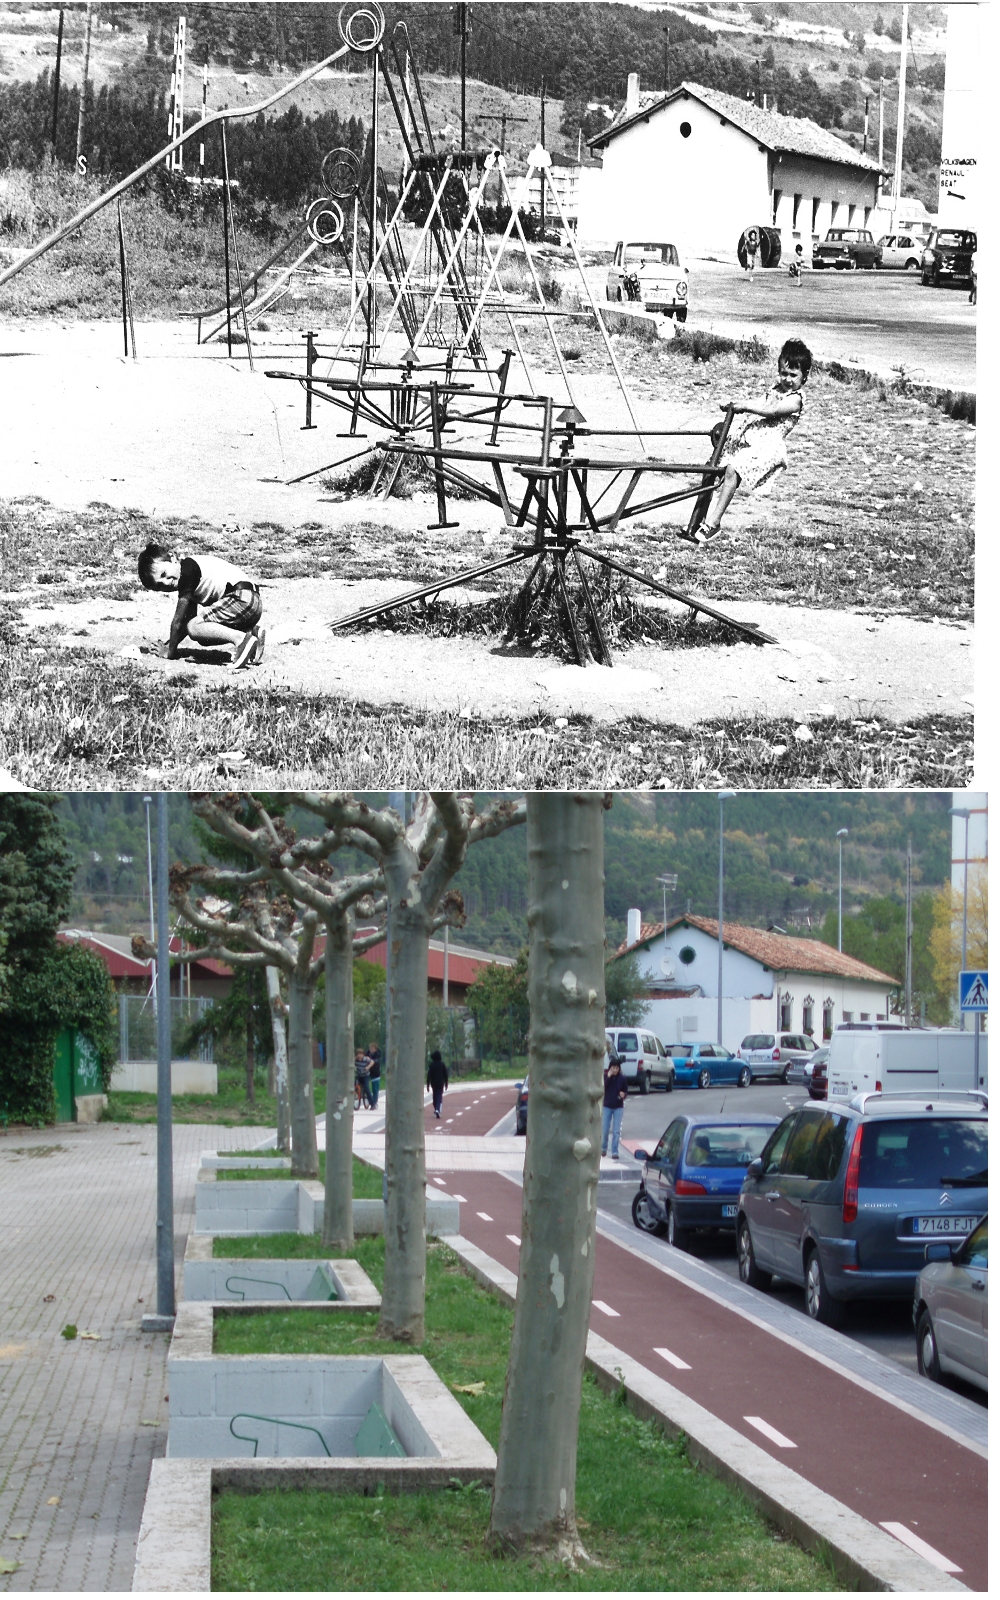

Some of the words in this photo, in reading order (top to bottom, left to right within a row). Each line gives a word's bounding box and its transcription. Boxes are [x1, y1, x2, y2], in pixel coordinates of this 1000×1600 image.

[78, 154, 88, 175] S
[941, 179, 957, 187] SEAT
[922, 1218, 950, 1231] 7148
[954, 1218, 974, 1231] FJT
